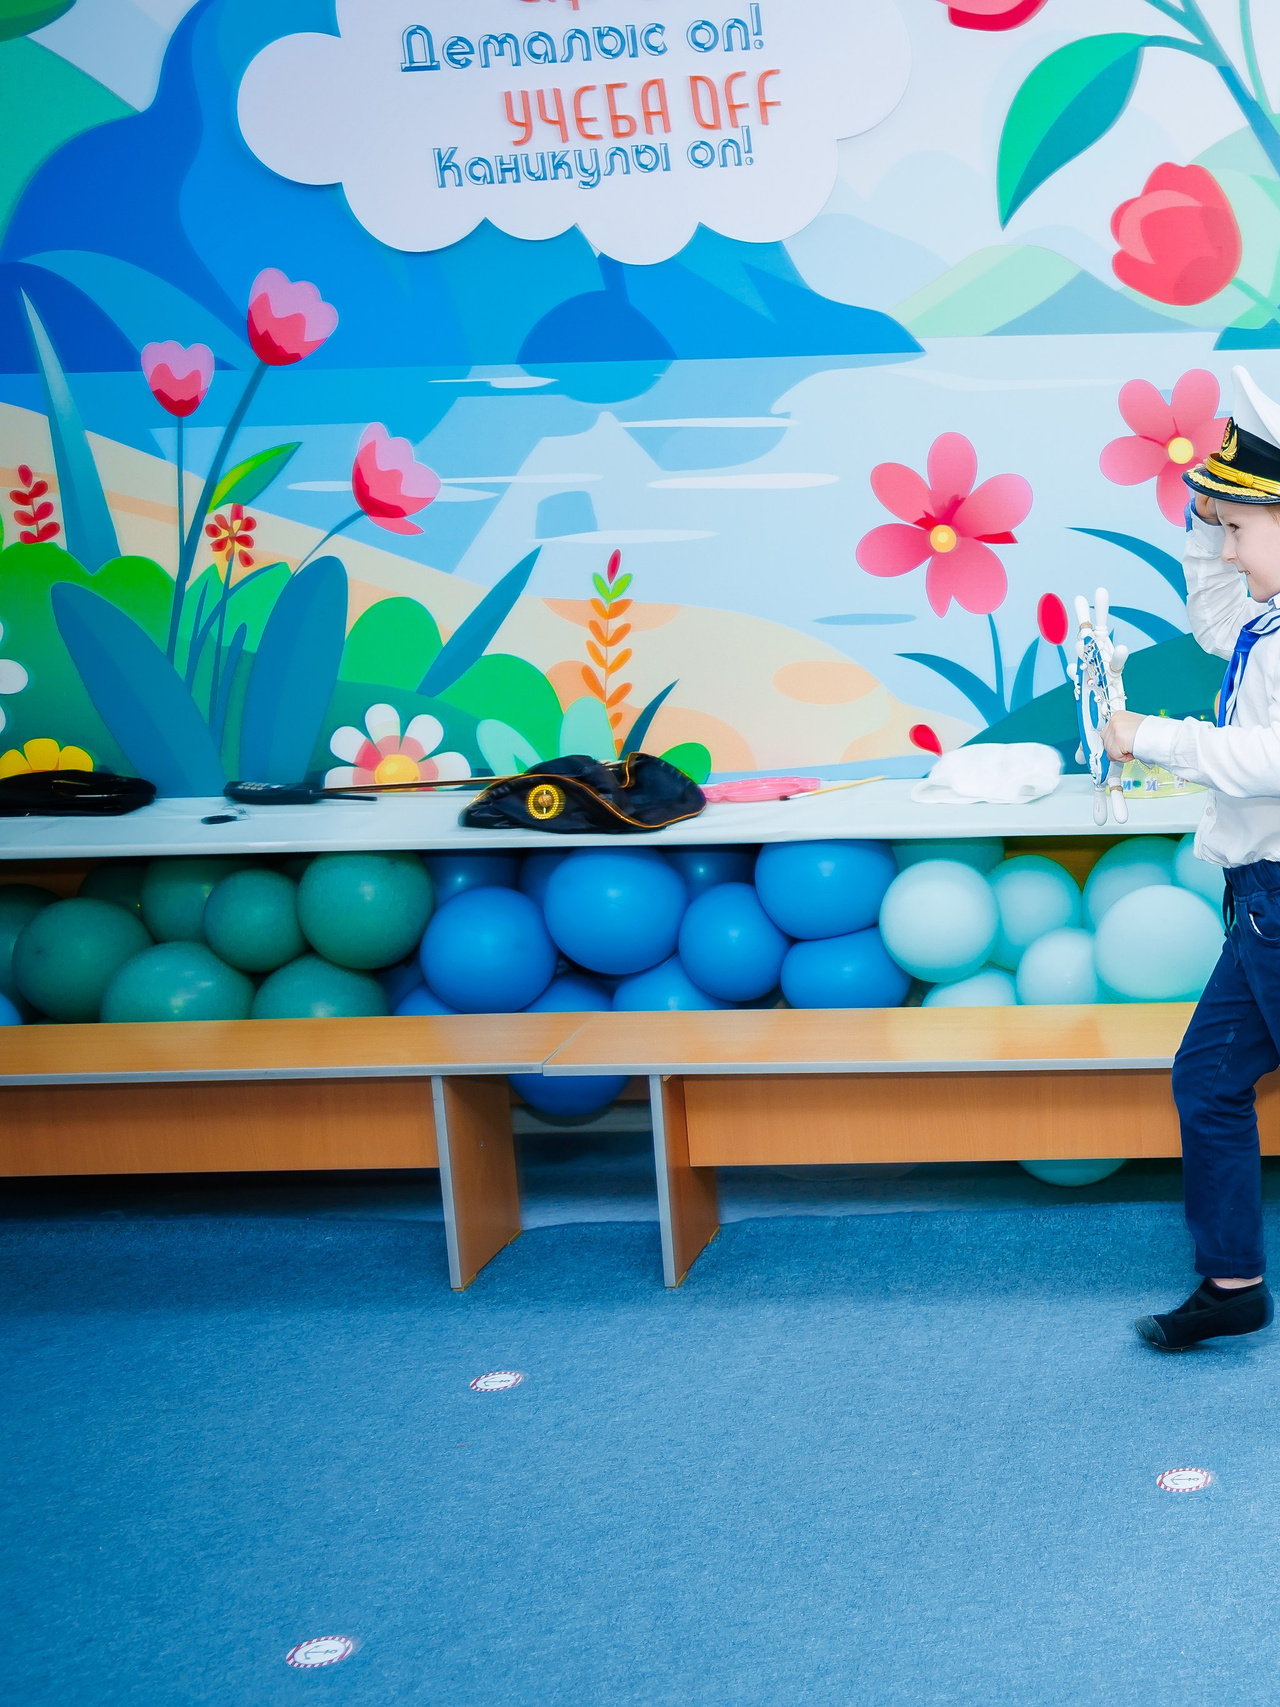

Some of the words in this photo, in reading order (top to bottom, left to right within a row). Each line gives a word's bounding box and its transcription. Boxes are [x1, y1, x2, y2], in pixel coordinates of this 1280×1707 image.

[399, 24, 669, 72] Демалыс
[502, 78, 672, 147] УЧЕБА
[432, 142, 672, 190] Каникулы
